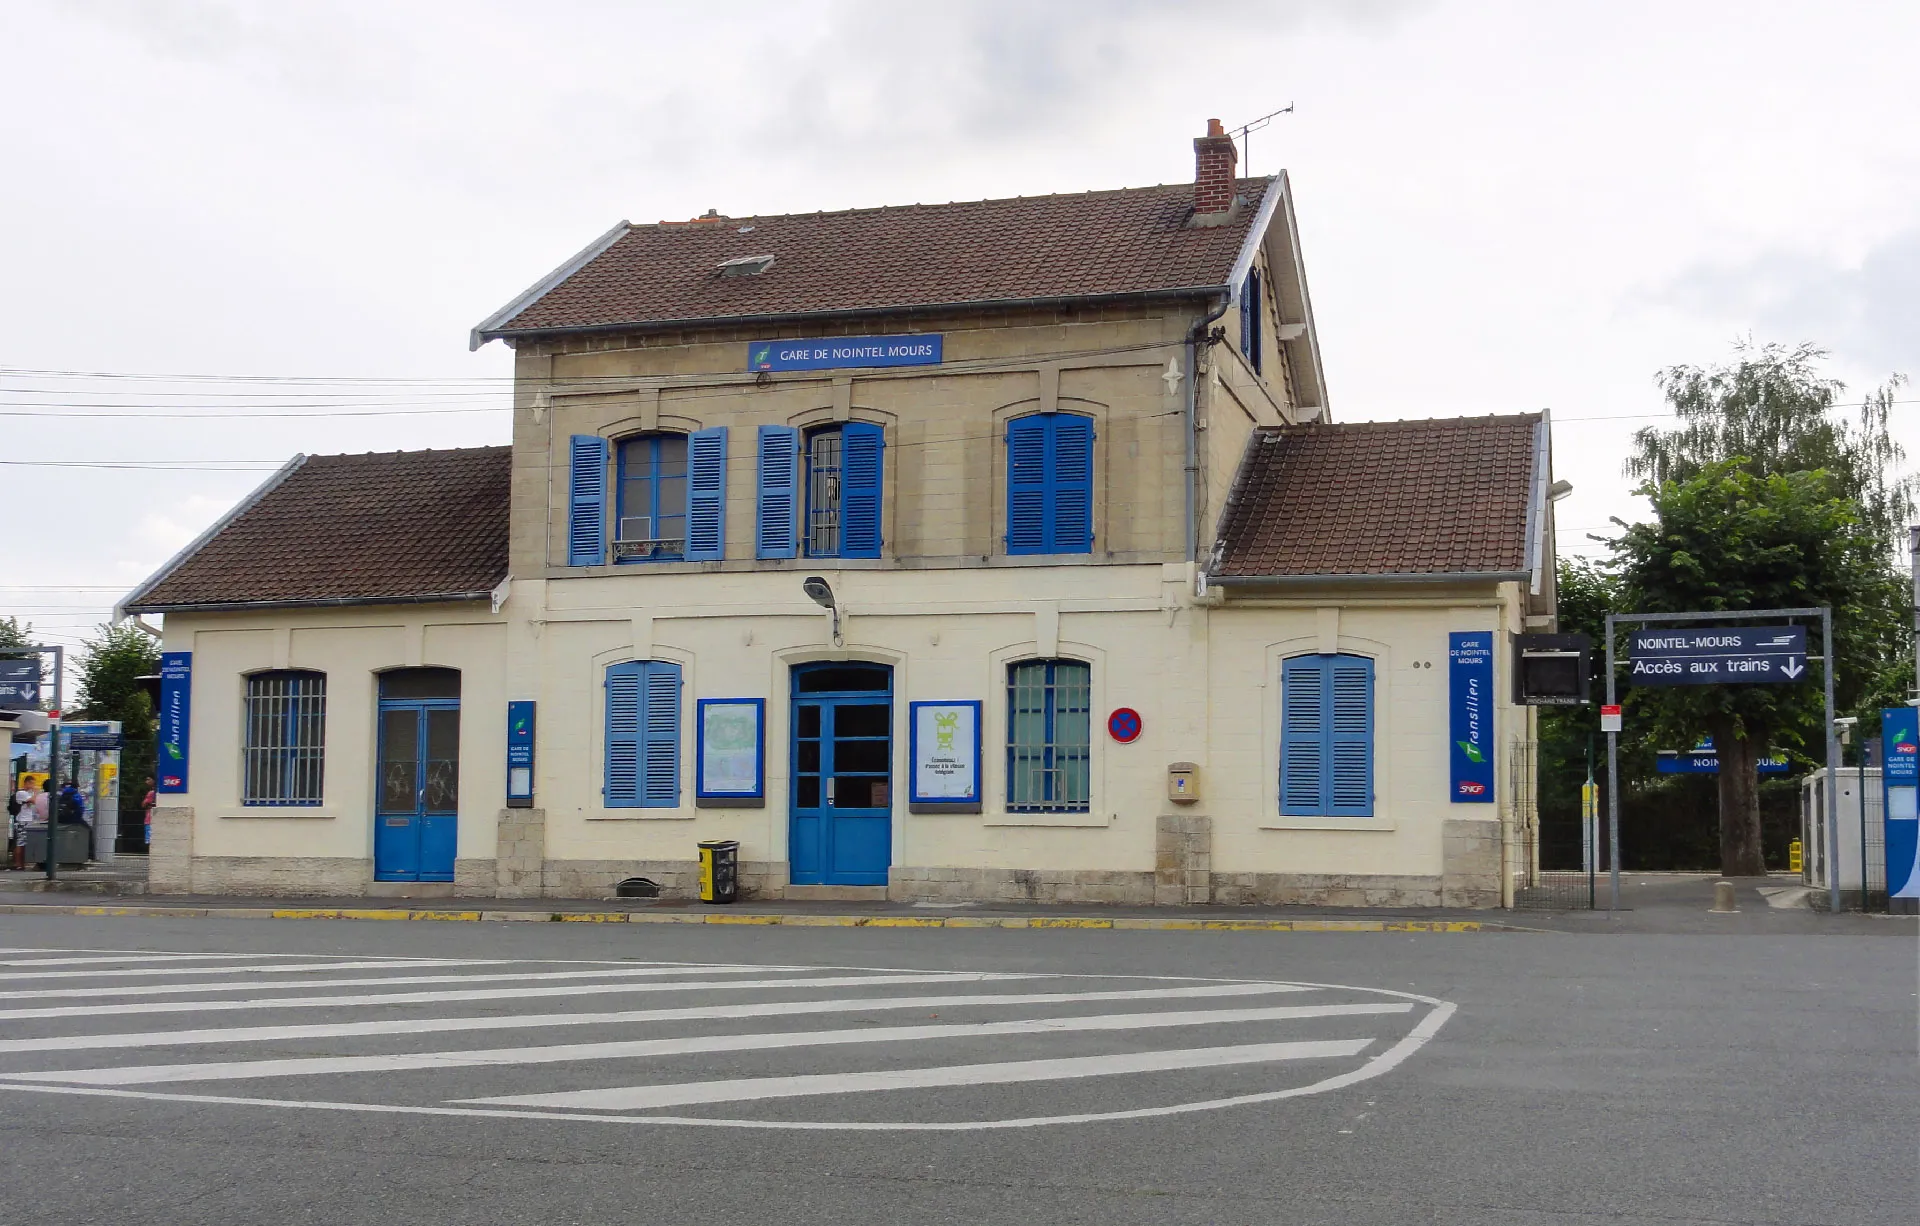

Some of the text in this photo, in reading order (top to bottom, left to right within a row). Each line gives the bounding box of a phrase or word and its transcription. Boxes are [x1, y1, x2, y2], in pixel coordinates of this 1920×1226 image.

[780, 344, 932, 361] GARE DE NOINTEL MOURS
[1638, 635, 1741, 649] NOINTEL-MOURS
[1633, 658, 1770, 674] Accès aux trains
[1466, 678, 1479, 754] Transilien
[1459, 785, 1483, 793] SNCF
